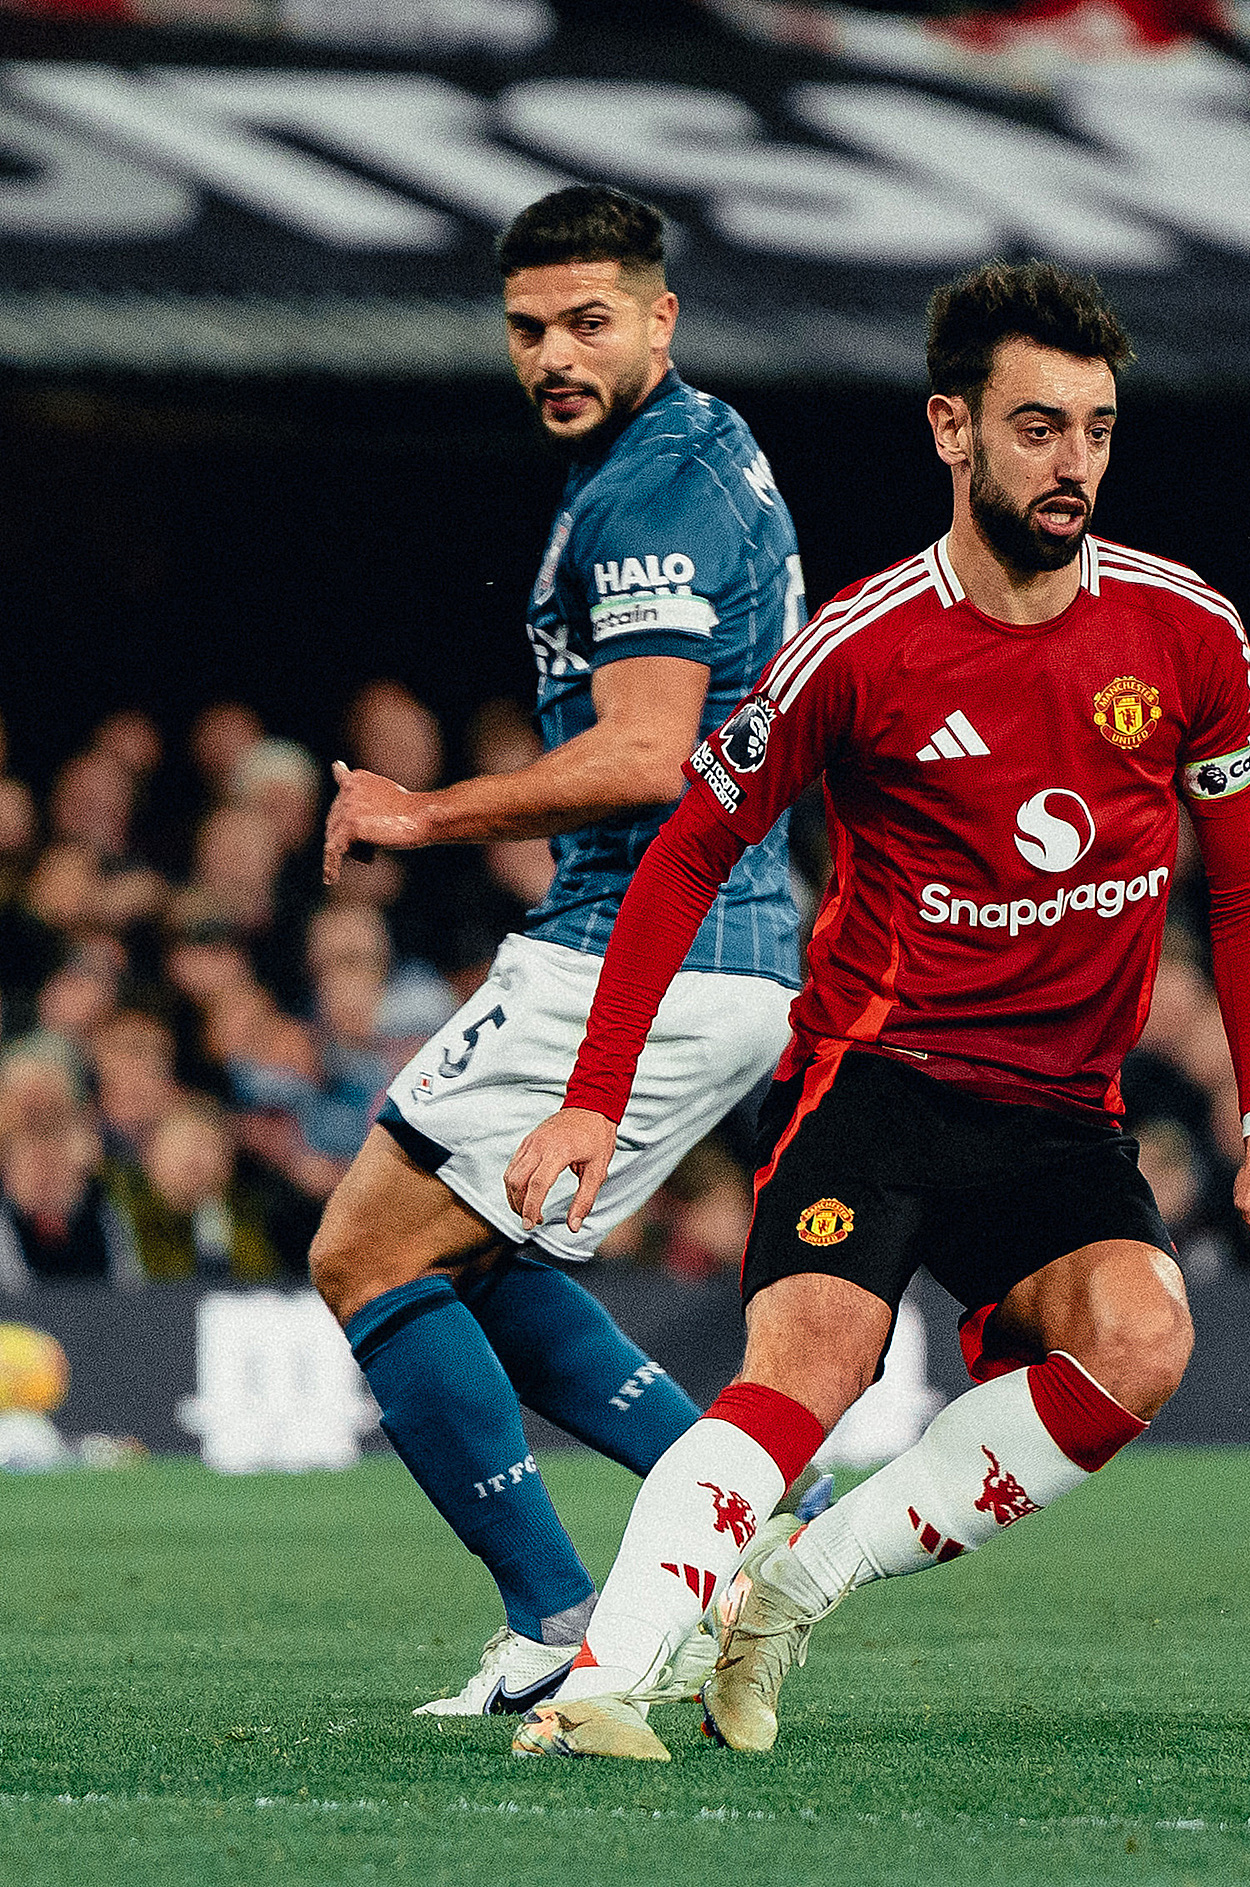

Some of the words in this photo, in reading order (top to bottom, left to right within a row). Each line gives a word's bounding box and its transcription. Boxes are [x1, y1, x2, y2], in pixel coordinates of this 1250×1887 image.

[594, 552, 696, 595] HALO
[1099, 681, 1155, 708] MANCHESTER
[1111, 729, 1149, 745] UNITED
[704, 769, 738, 814] racism
[712, 761, 740, 800] room
[919, 866, 1169, 937] Snapdragon
[438, 1004, 507, 1079] 5
[473, 1454, 538, 1499] ITFC
